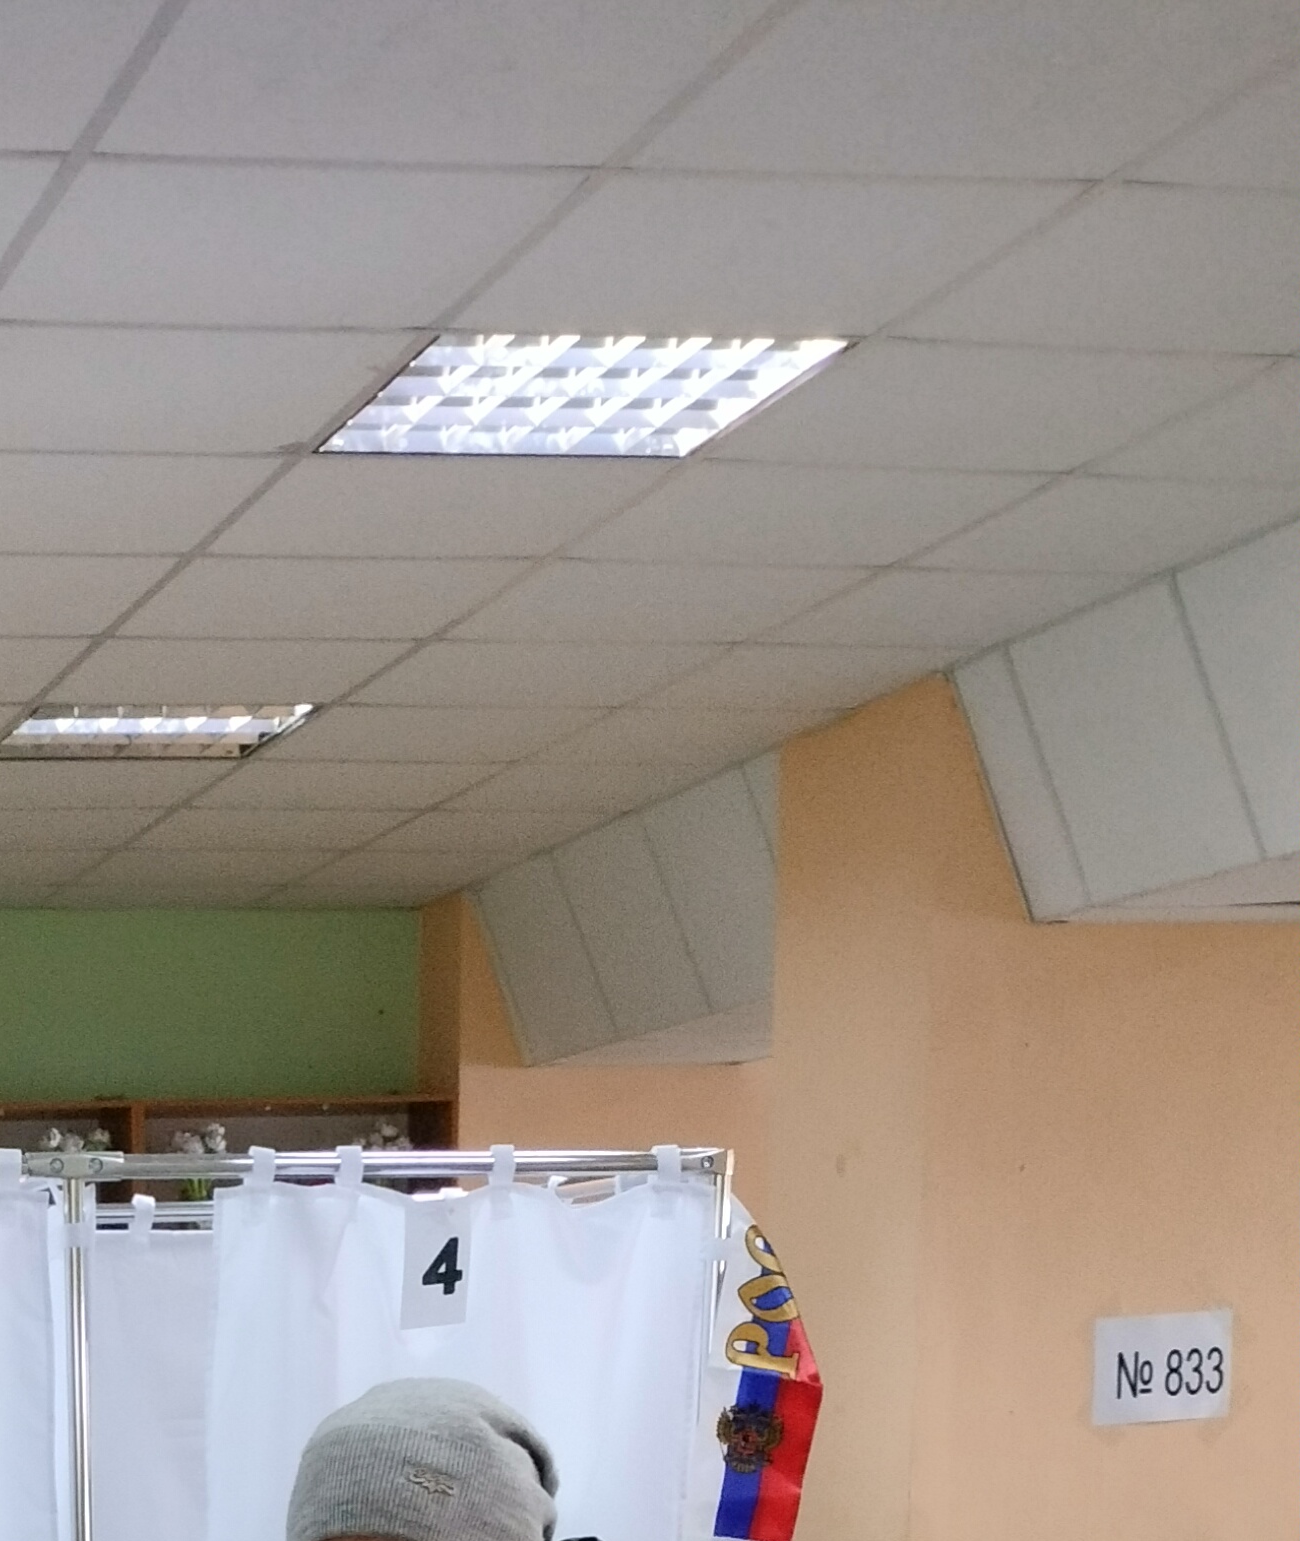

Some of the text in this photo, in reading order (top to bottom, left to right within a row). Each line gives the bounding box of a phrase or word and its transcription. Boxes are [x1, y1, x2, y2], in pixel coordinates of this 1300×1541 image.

[422, 1236, 463, 1296] 4
[1116, 1347, 1224, 1400] № 833
